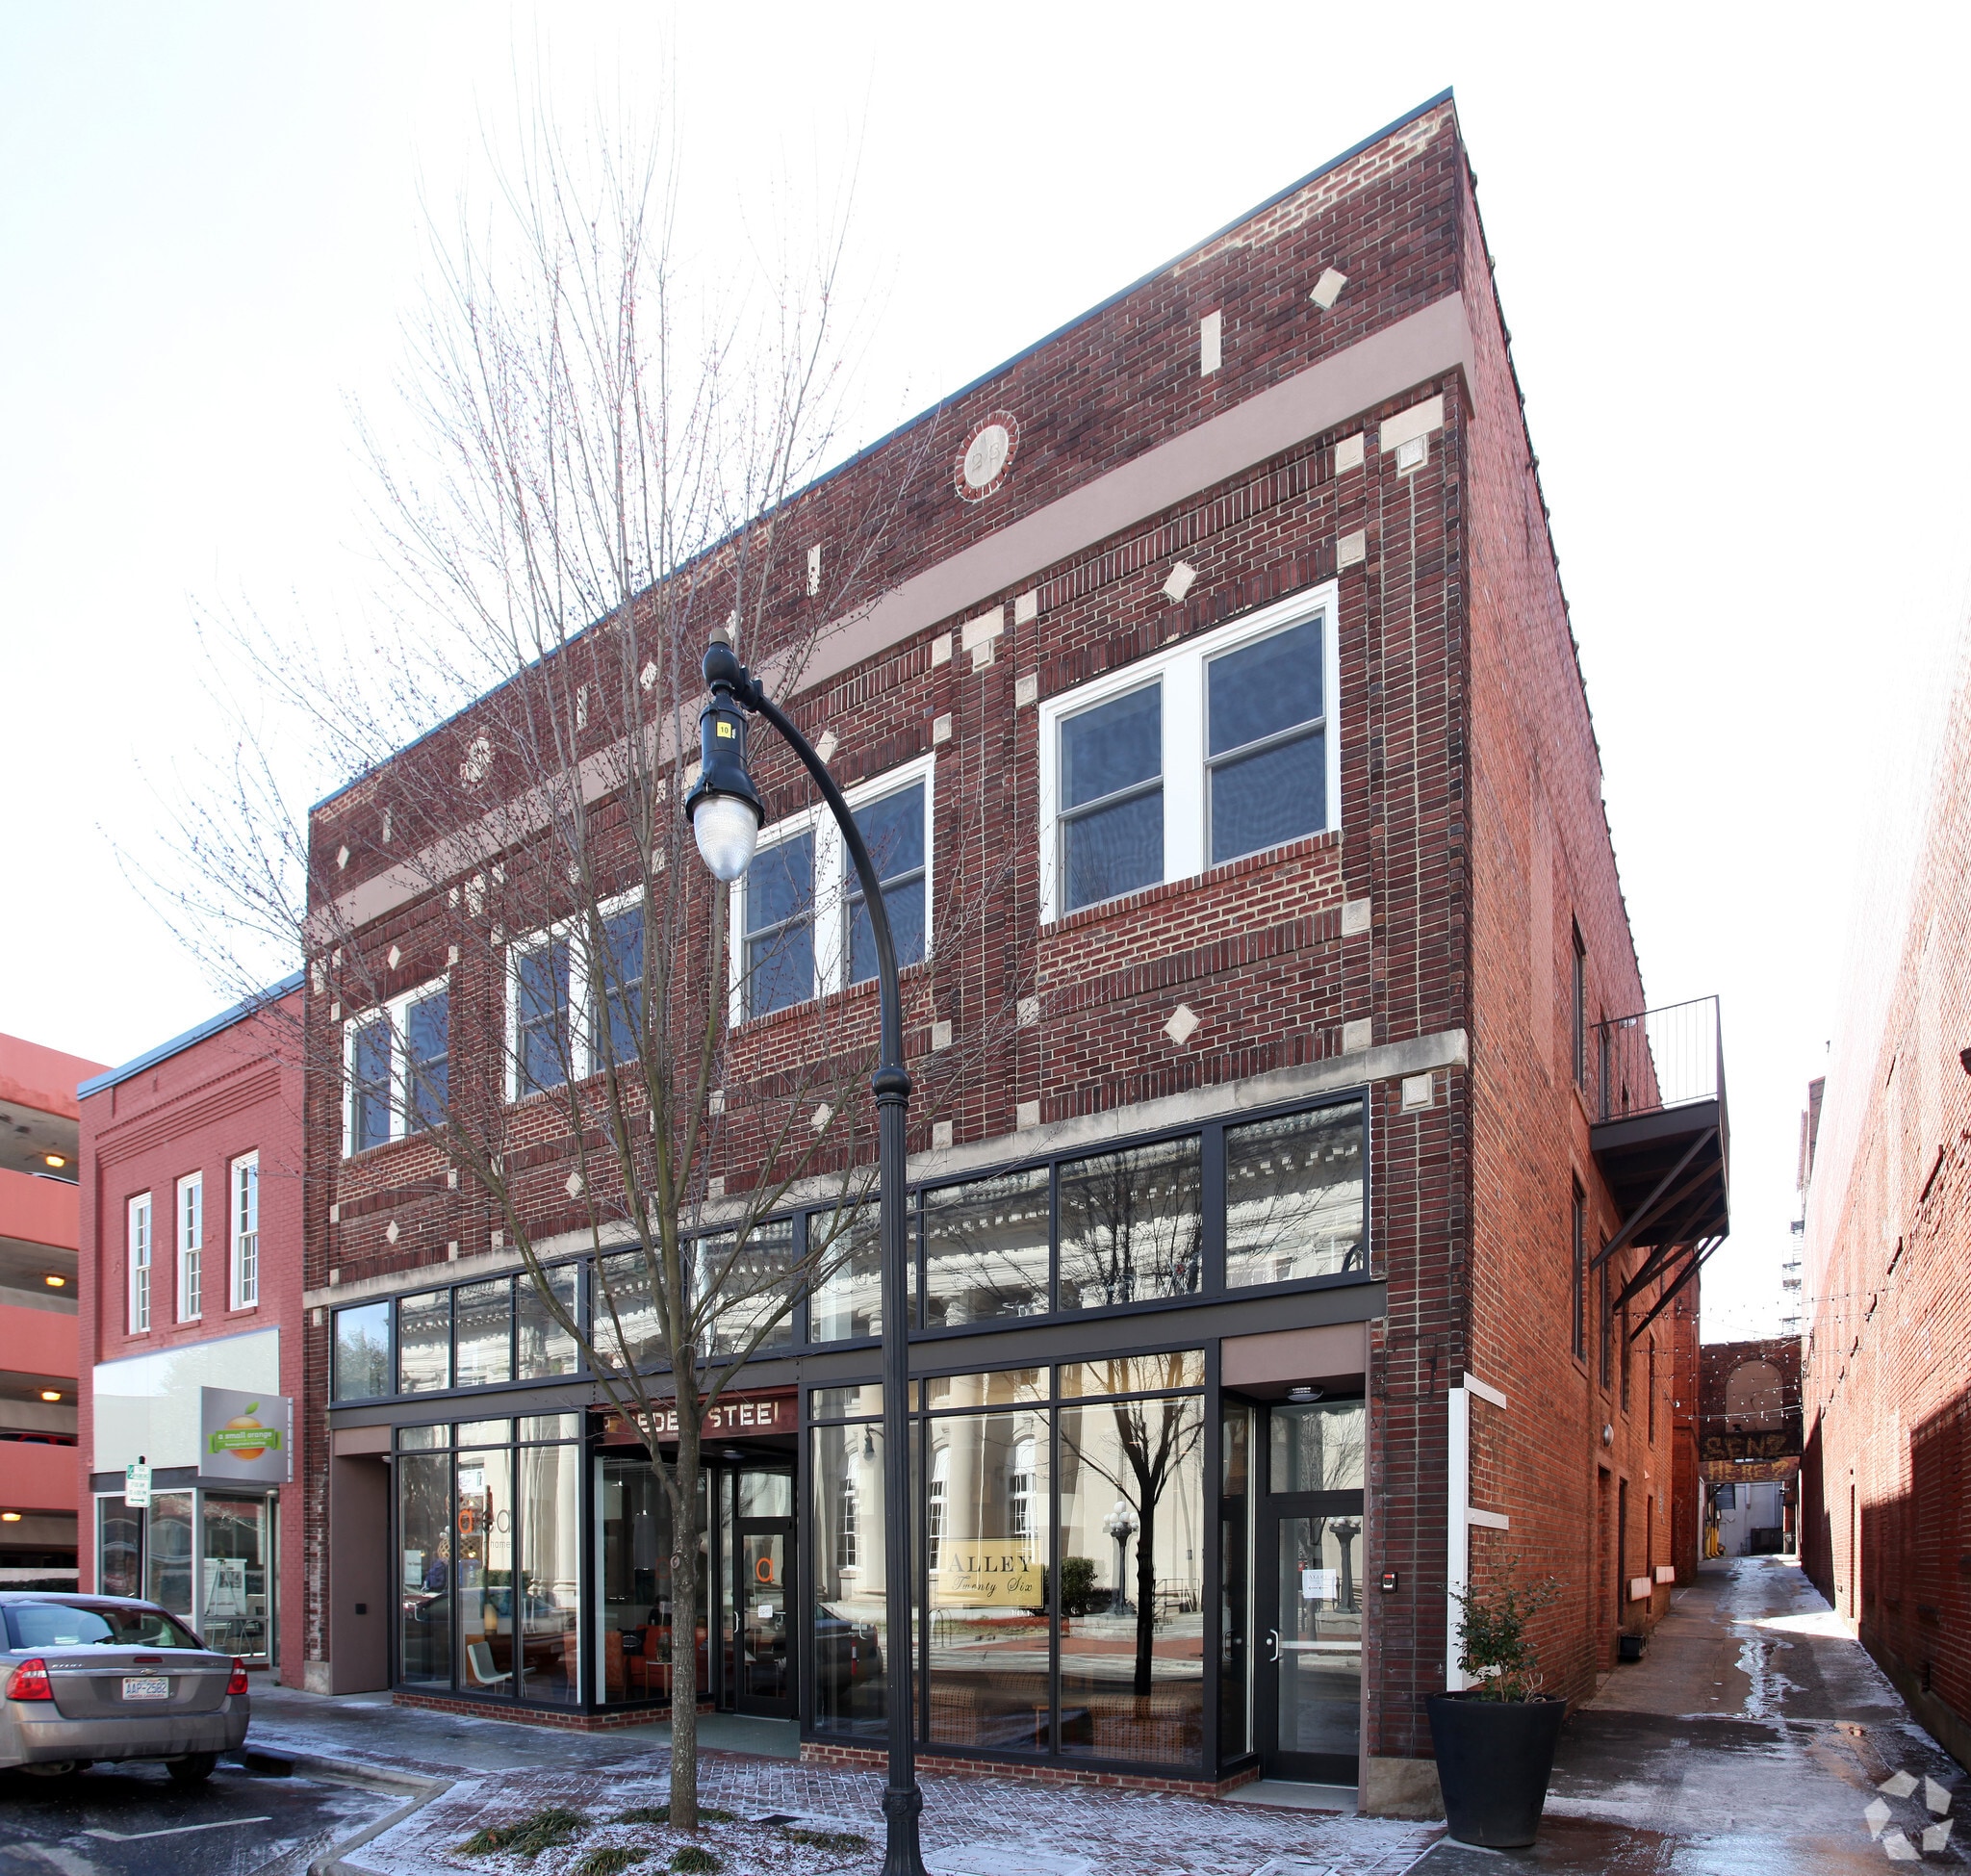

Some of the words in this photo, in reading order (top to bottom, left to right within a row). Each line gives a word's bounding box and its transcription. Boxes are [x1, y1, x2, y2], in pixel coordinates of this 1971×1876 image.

[721, 726, 729, 734] 10
[224, 1431, 246, 1440] small
[949, 1554, 1032, 1572] ALLEY
[952, 1575, 997, 1597] Twenty
[1007, 1575, 1033, 1595] Six
